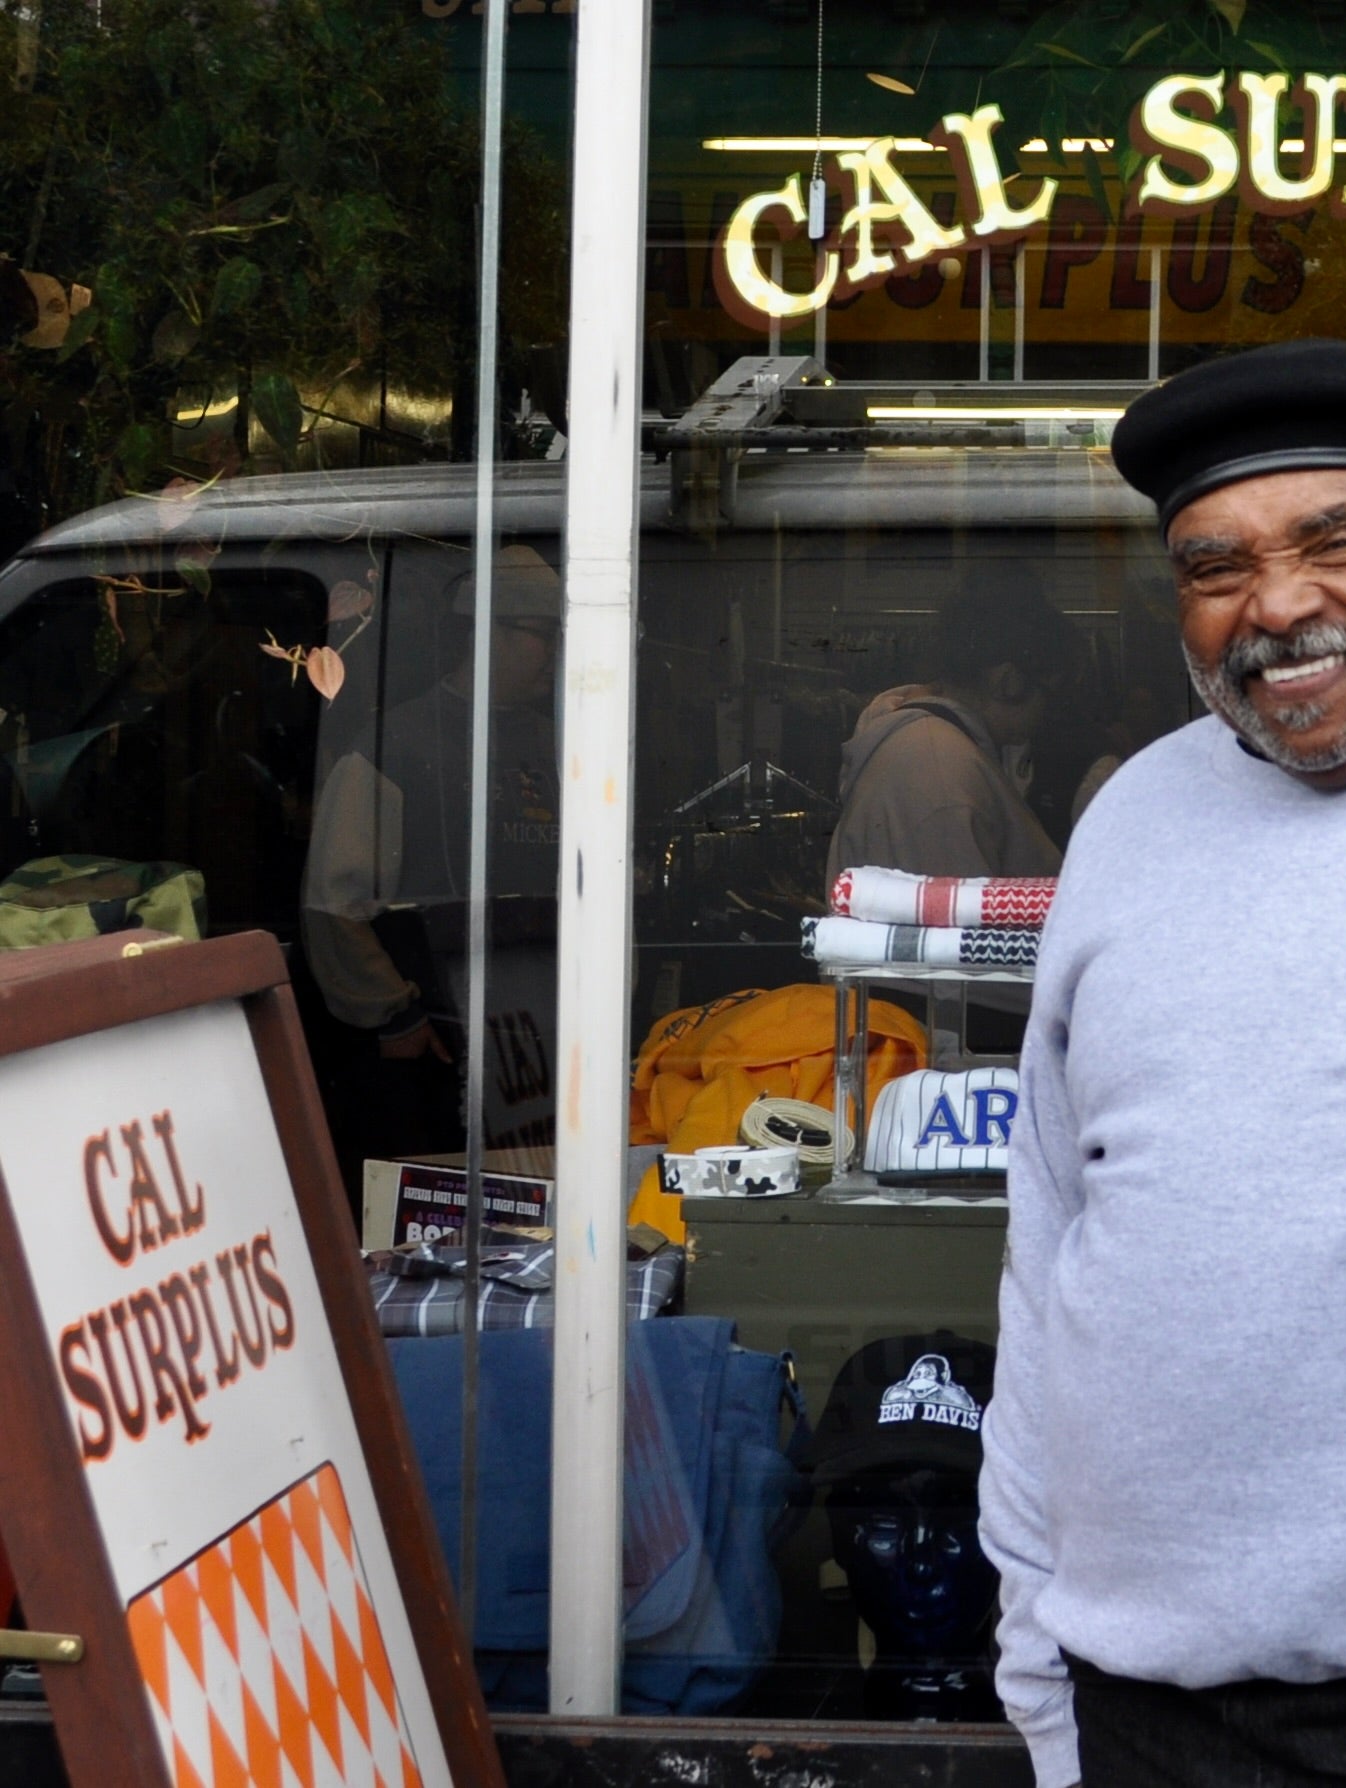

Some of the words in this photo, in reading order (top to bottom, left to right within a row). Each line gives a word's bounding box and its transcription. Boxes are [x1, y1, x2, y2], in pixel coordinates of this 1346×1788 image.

[722, 103, 1058, 322] CAL
[82, 1109, 204, 1268] CAL
[913, 1085, 1020, 1149] AR
[58, 1226, 297, 1464] SURPLUS
[877, 1402, 915, 1424] BEN
[921, 1403, 980, 1432] DAVIS
